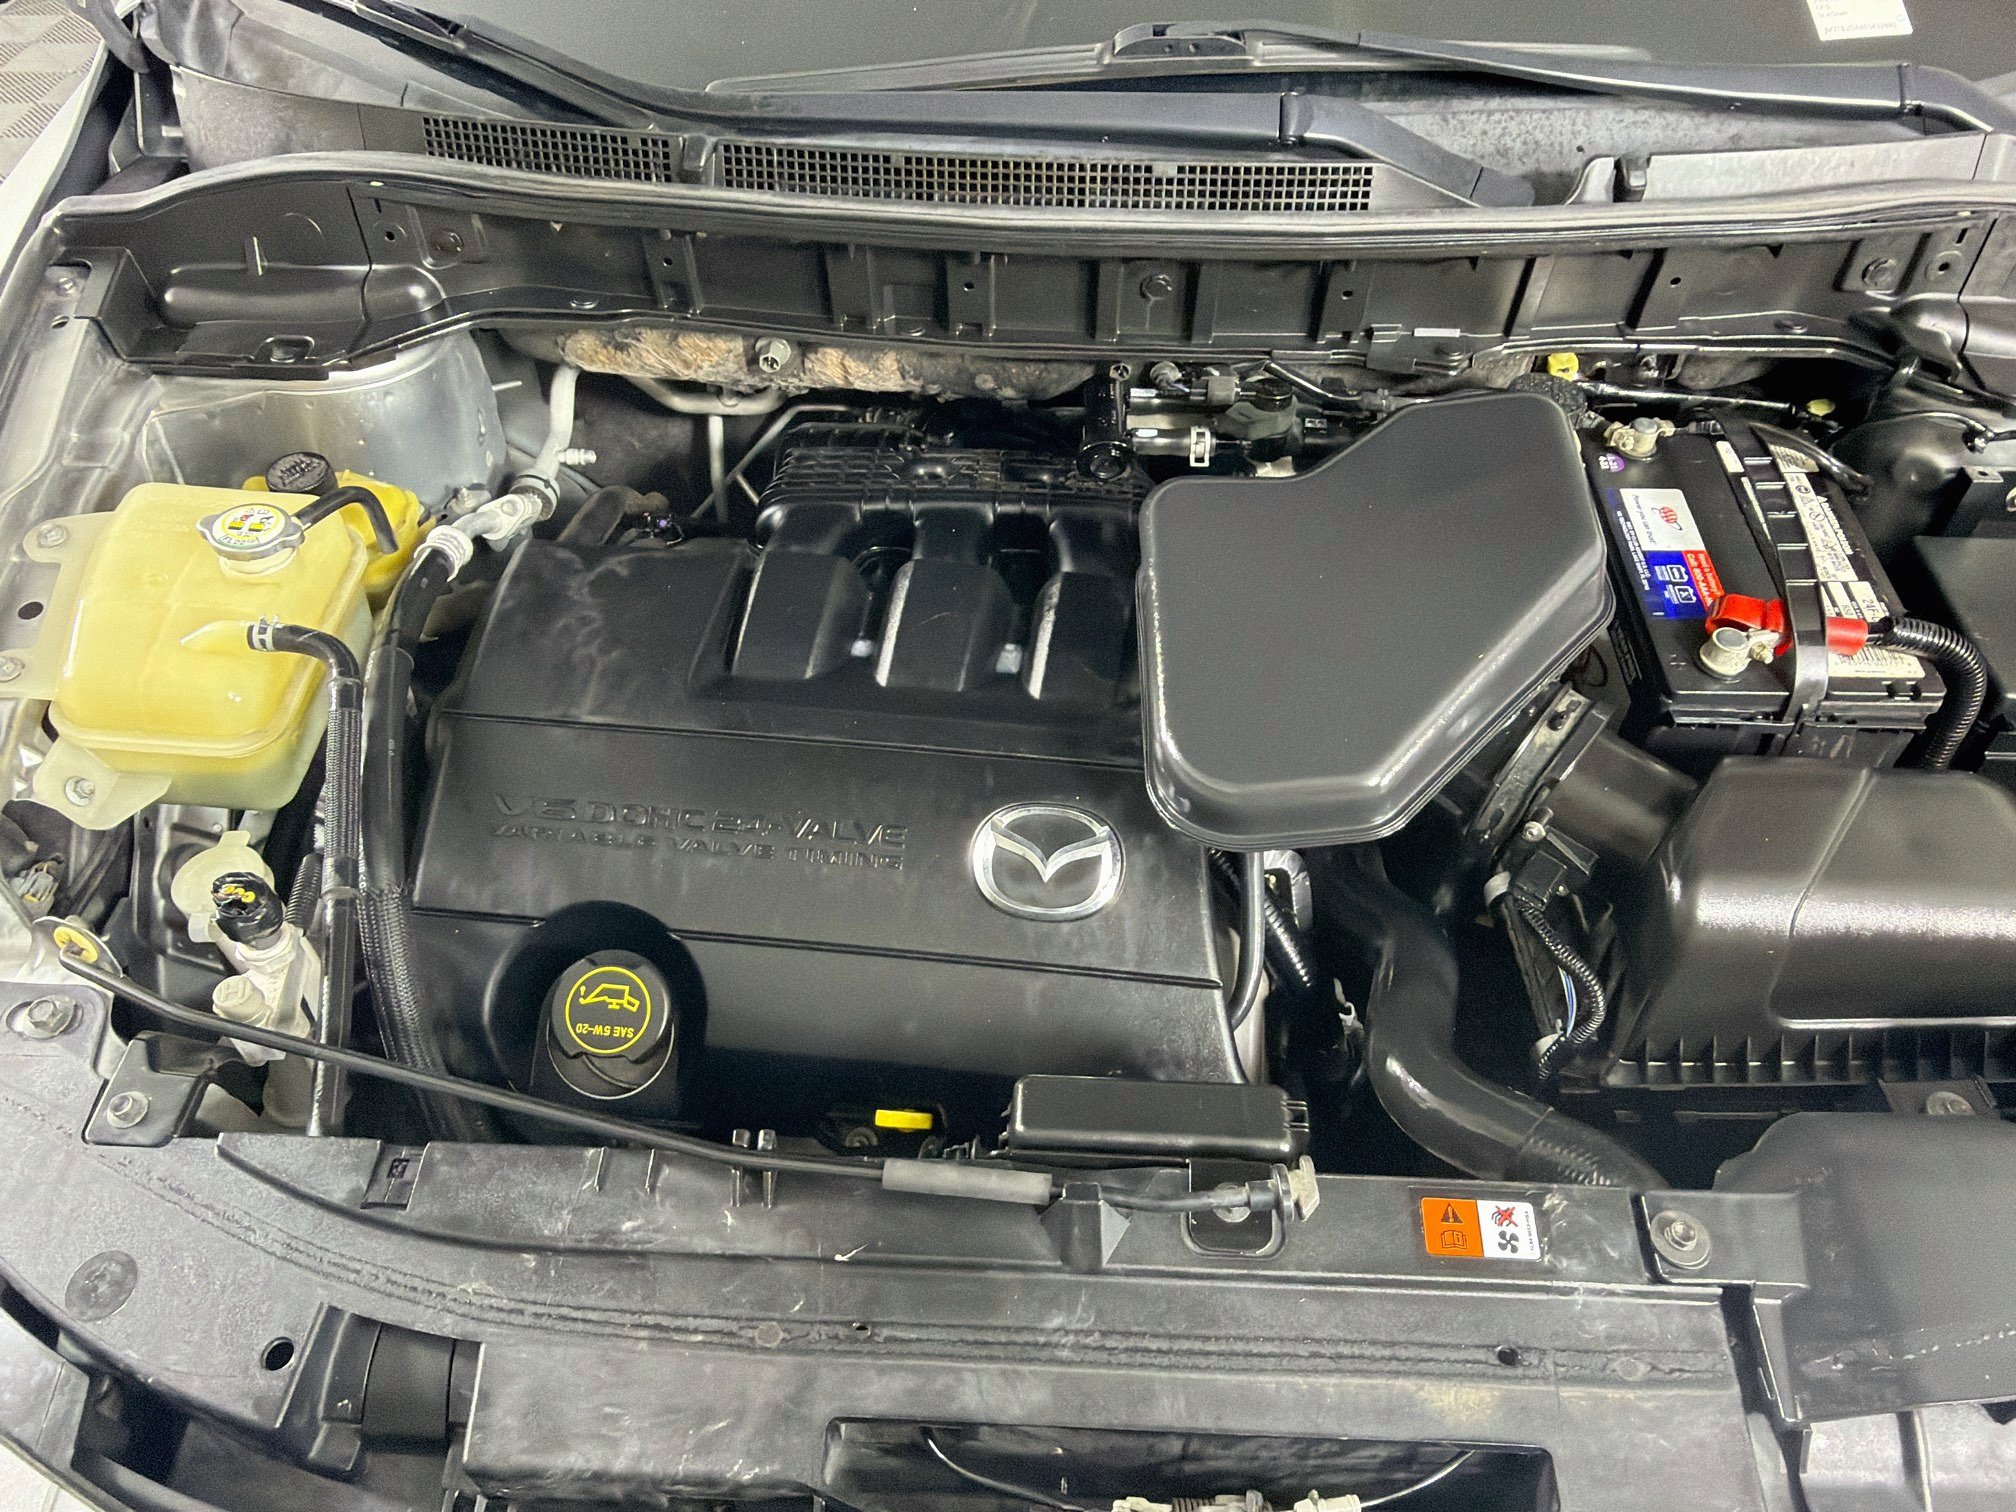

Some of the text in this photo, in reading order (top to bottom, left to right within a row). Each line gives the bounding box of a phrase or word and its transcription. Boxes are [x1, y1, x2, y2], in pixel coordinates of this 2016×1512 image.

[583, 800, 706, 832] DOHC
[672, 836, 775, 860] VALVE
[786, 847, 905, 871] TIMING
[576, 1023, 635, 1039] SAE 5W-20
